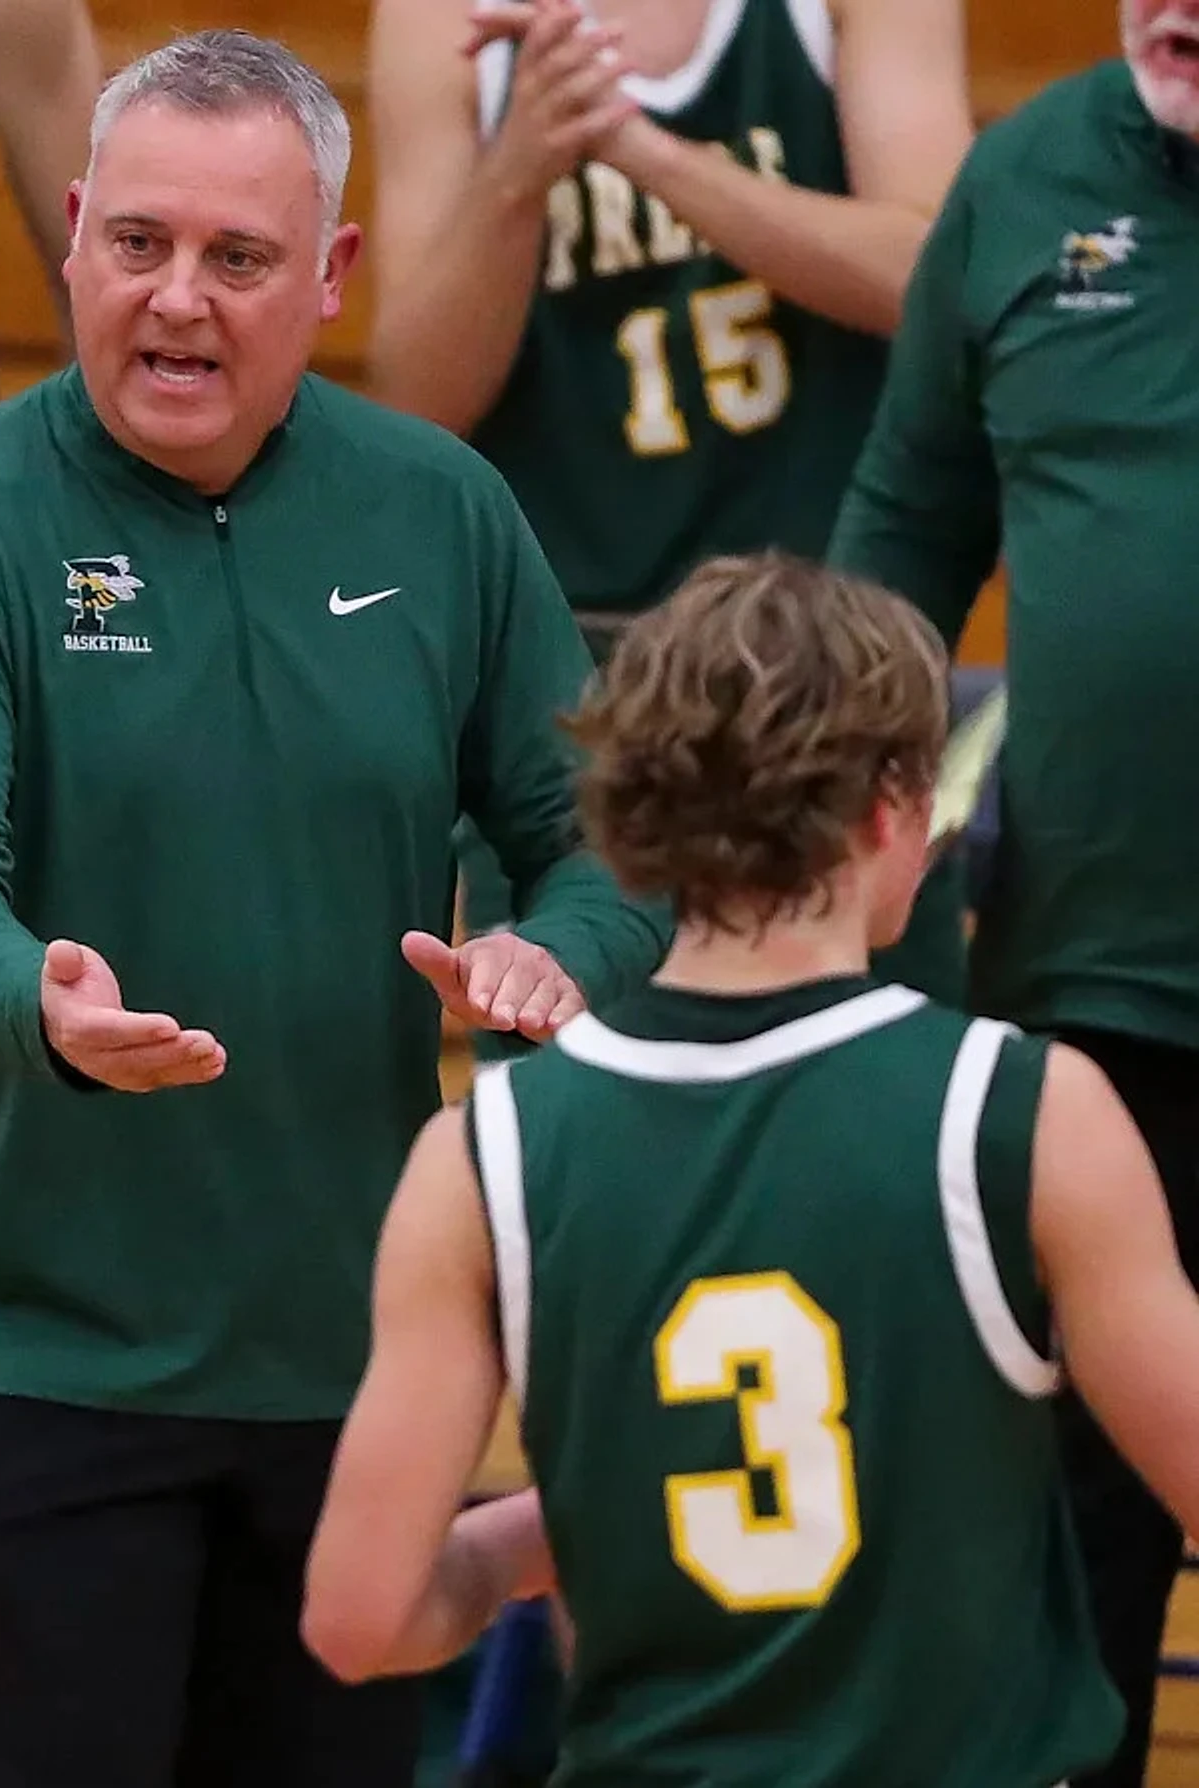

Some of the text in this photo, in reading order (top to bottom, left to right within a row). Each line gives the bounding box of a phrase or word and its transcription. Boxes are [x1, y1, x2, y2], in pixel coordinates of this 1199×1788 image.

[616, 279, 791, 456] 15
[63, 634, 153, 652] BASKETBALL
[653, 1269, 861, 1613] 3
